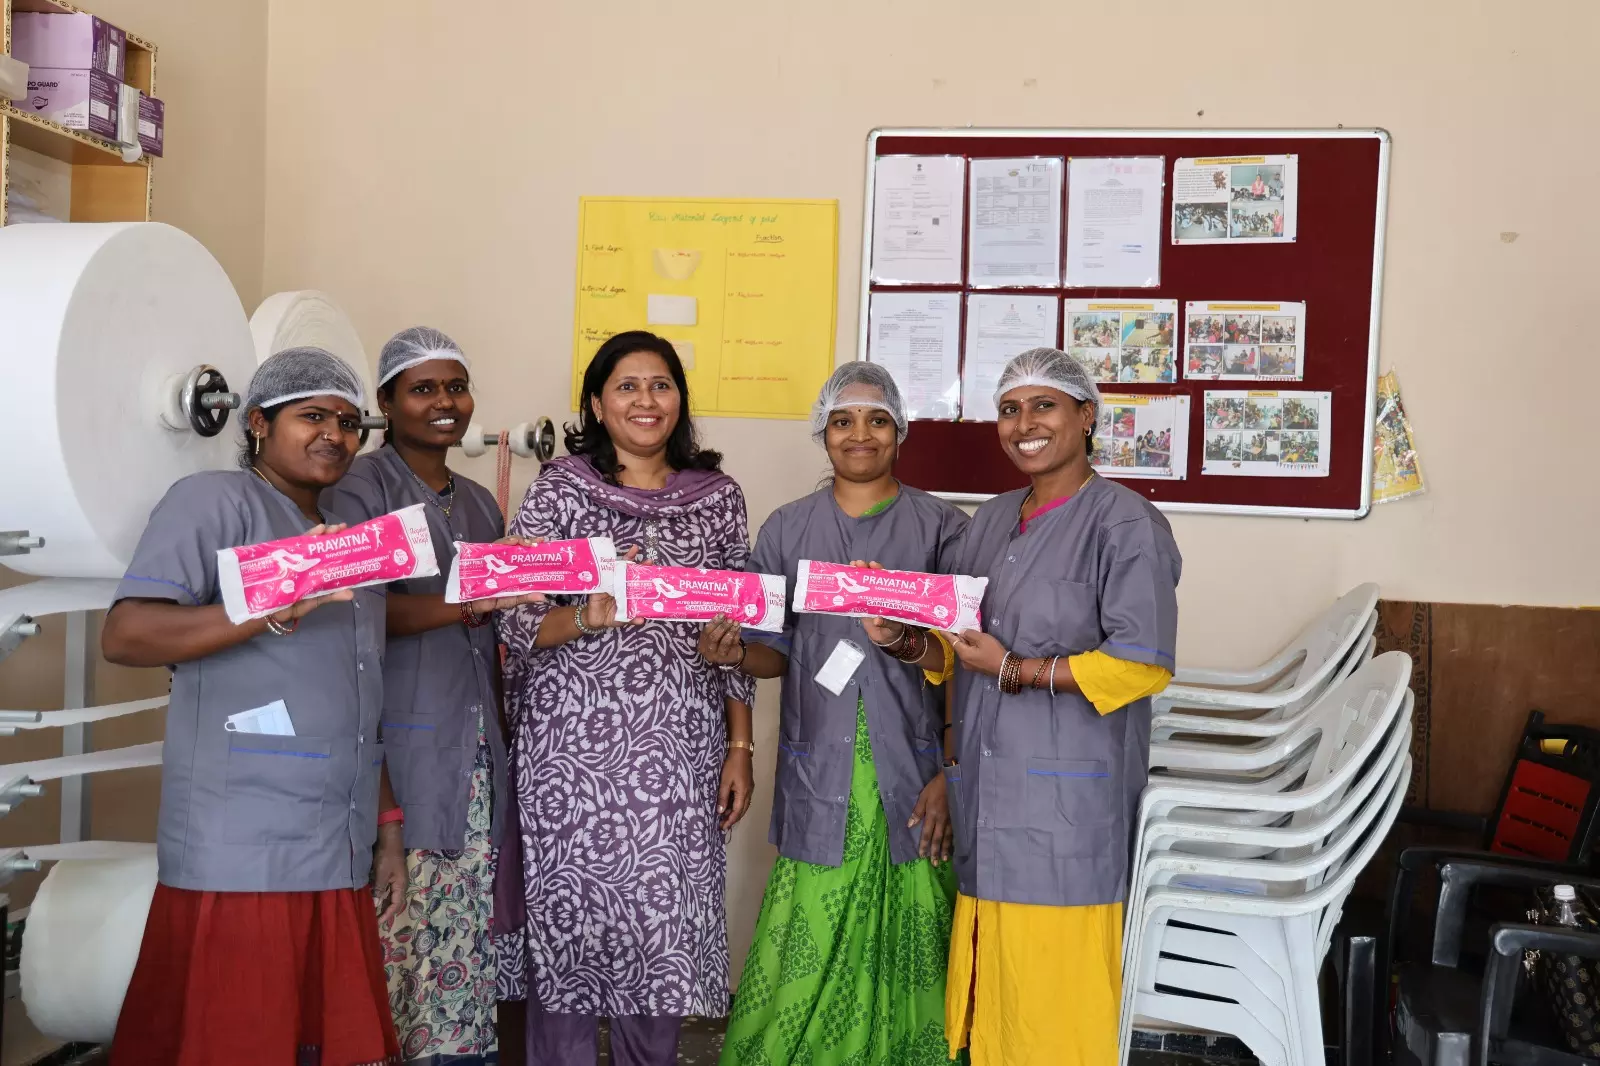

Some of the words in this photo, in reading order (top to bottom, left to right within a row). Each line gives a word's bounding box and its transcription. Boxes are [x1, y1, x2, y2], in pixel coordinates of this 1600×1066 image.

[308, 532, 370, 556] PRAYATNA
[510, 552, 563, 564] PRAYATNA
[323, 567, 365, 582] SANITARY
[364, 562, 382, 573] PAD
[679, 580, 728, 592] PRAYATNA
[862, 575, 917, 590] PRAYATNA
[866, 600, 903, 610] SANITARY
[902, 605, 920, 613] PAD
